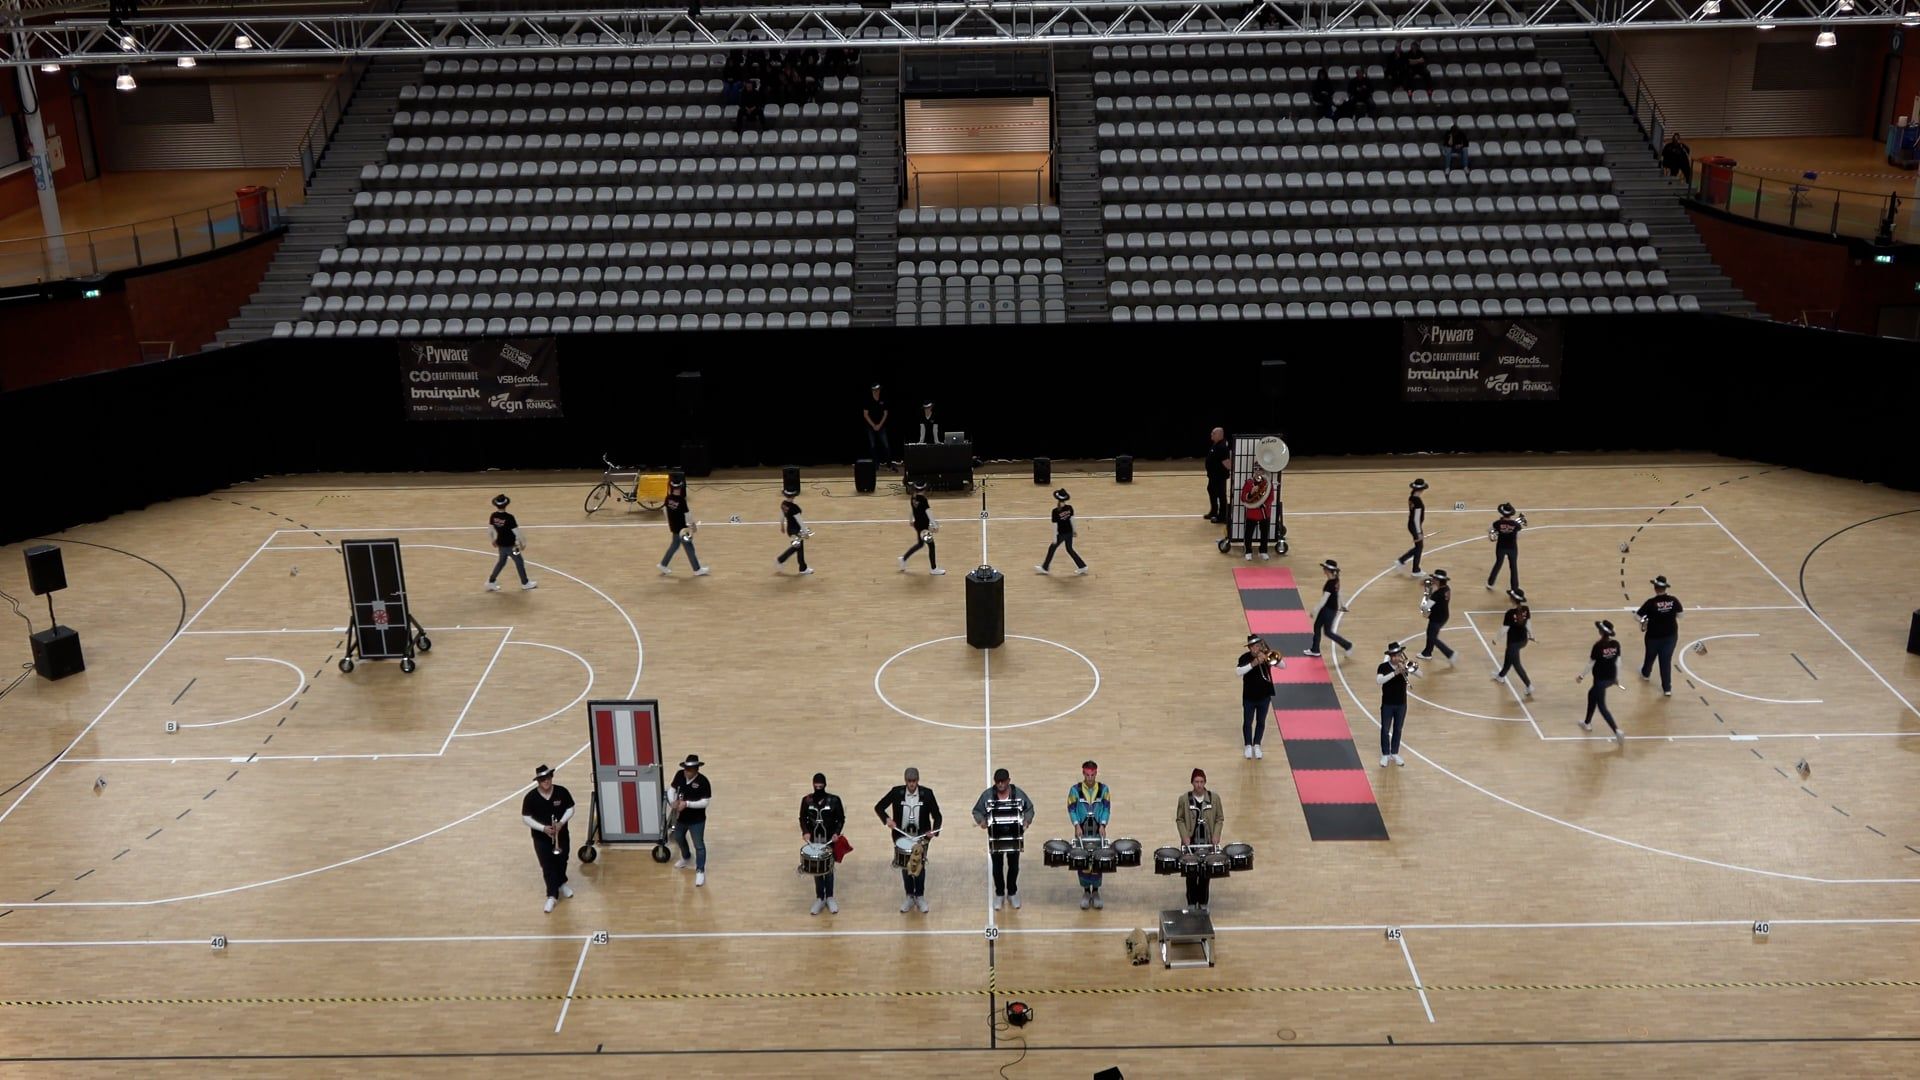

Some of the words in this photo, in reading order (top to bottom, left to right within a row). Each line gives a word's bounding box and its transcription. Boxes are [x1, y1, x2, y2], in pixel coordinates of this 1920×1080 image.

[1431, 325, 1474, 345] Pyware
[425, 345, 469, 364] Pyware
[1407, 367, 1479, 382] brainpink
[410, 386, 481, 401] brainpink
[1495, 382, 1519, 395] cgn
[499, 400, 523, 413] cgn
[985, 928, 998, 938] 50
[1389, 928, 1401, 939] 45
[1756, 923, 1769, 934] 40
[211, 938, 224, 947] 40
[593, 934, 607, 944] 45
